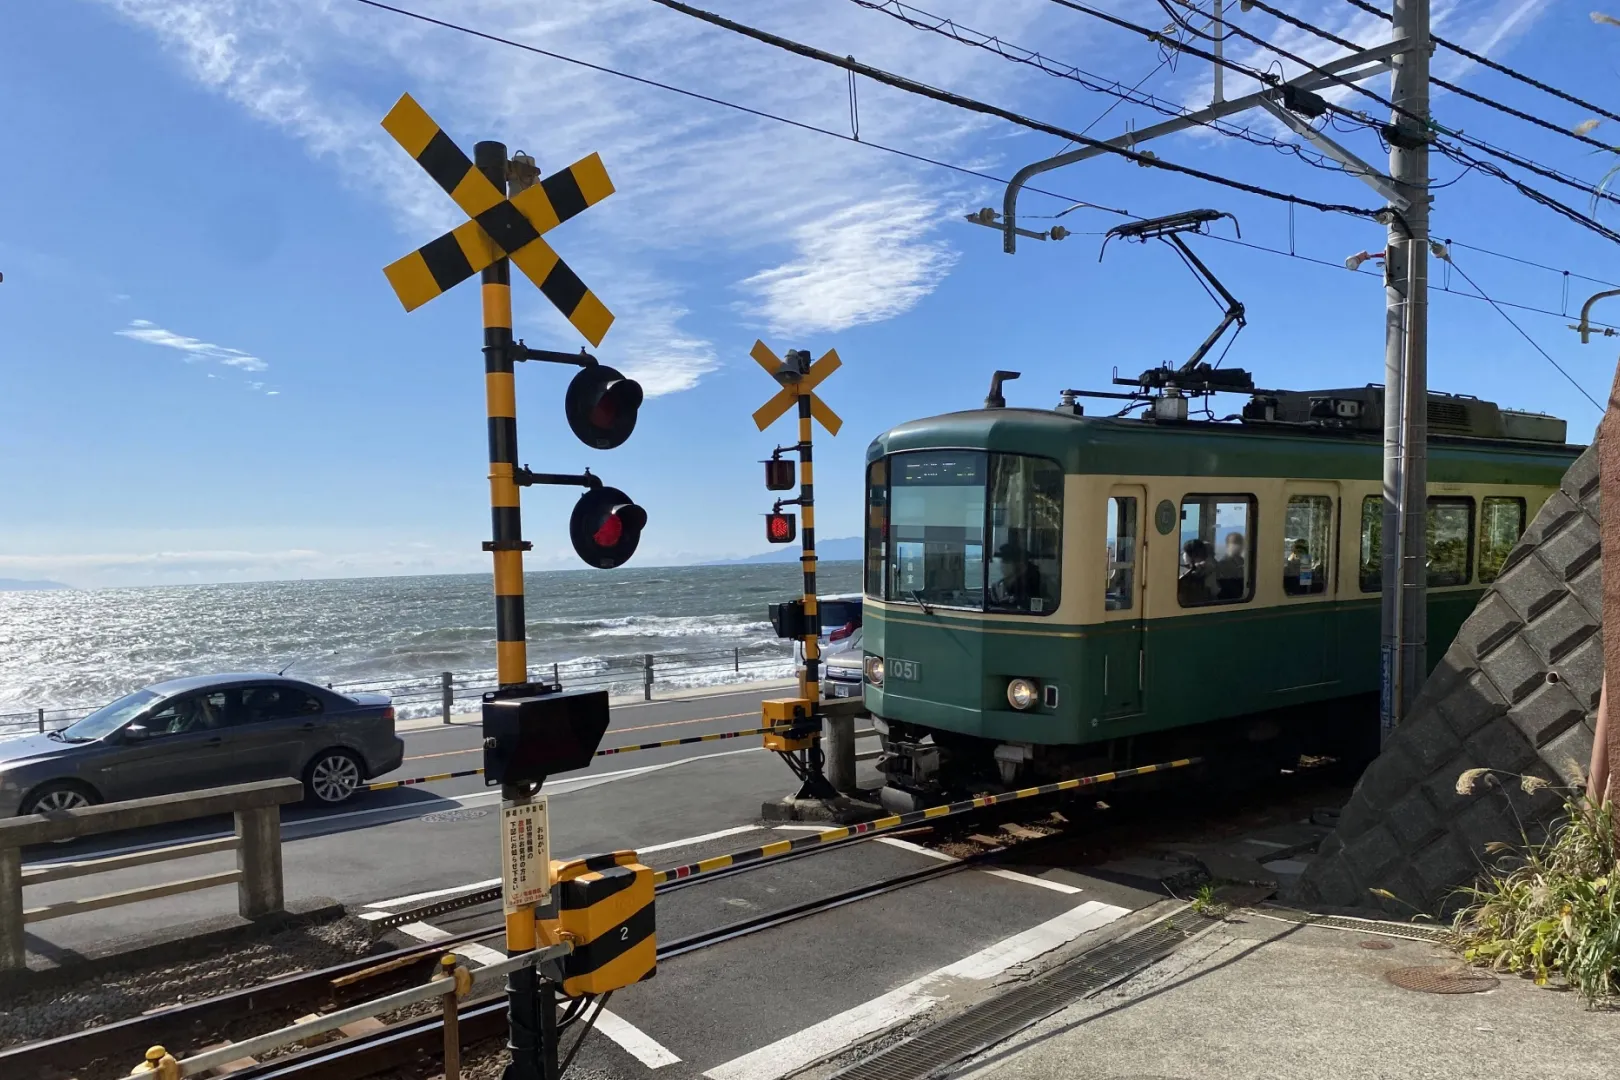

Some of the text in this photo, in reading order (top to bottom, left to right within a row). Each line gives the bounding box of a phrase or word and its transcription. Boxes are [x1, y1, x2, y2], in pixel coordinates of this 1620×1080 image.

[890, 660, 917, 681] 1051
[537, 826, 545, 855] おねがい
[620, 926, 629, 941] 2
